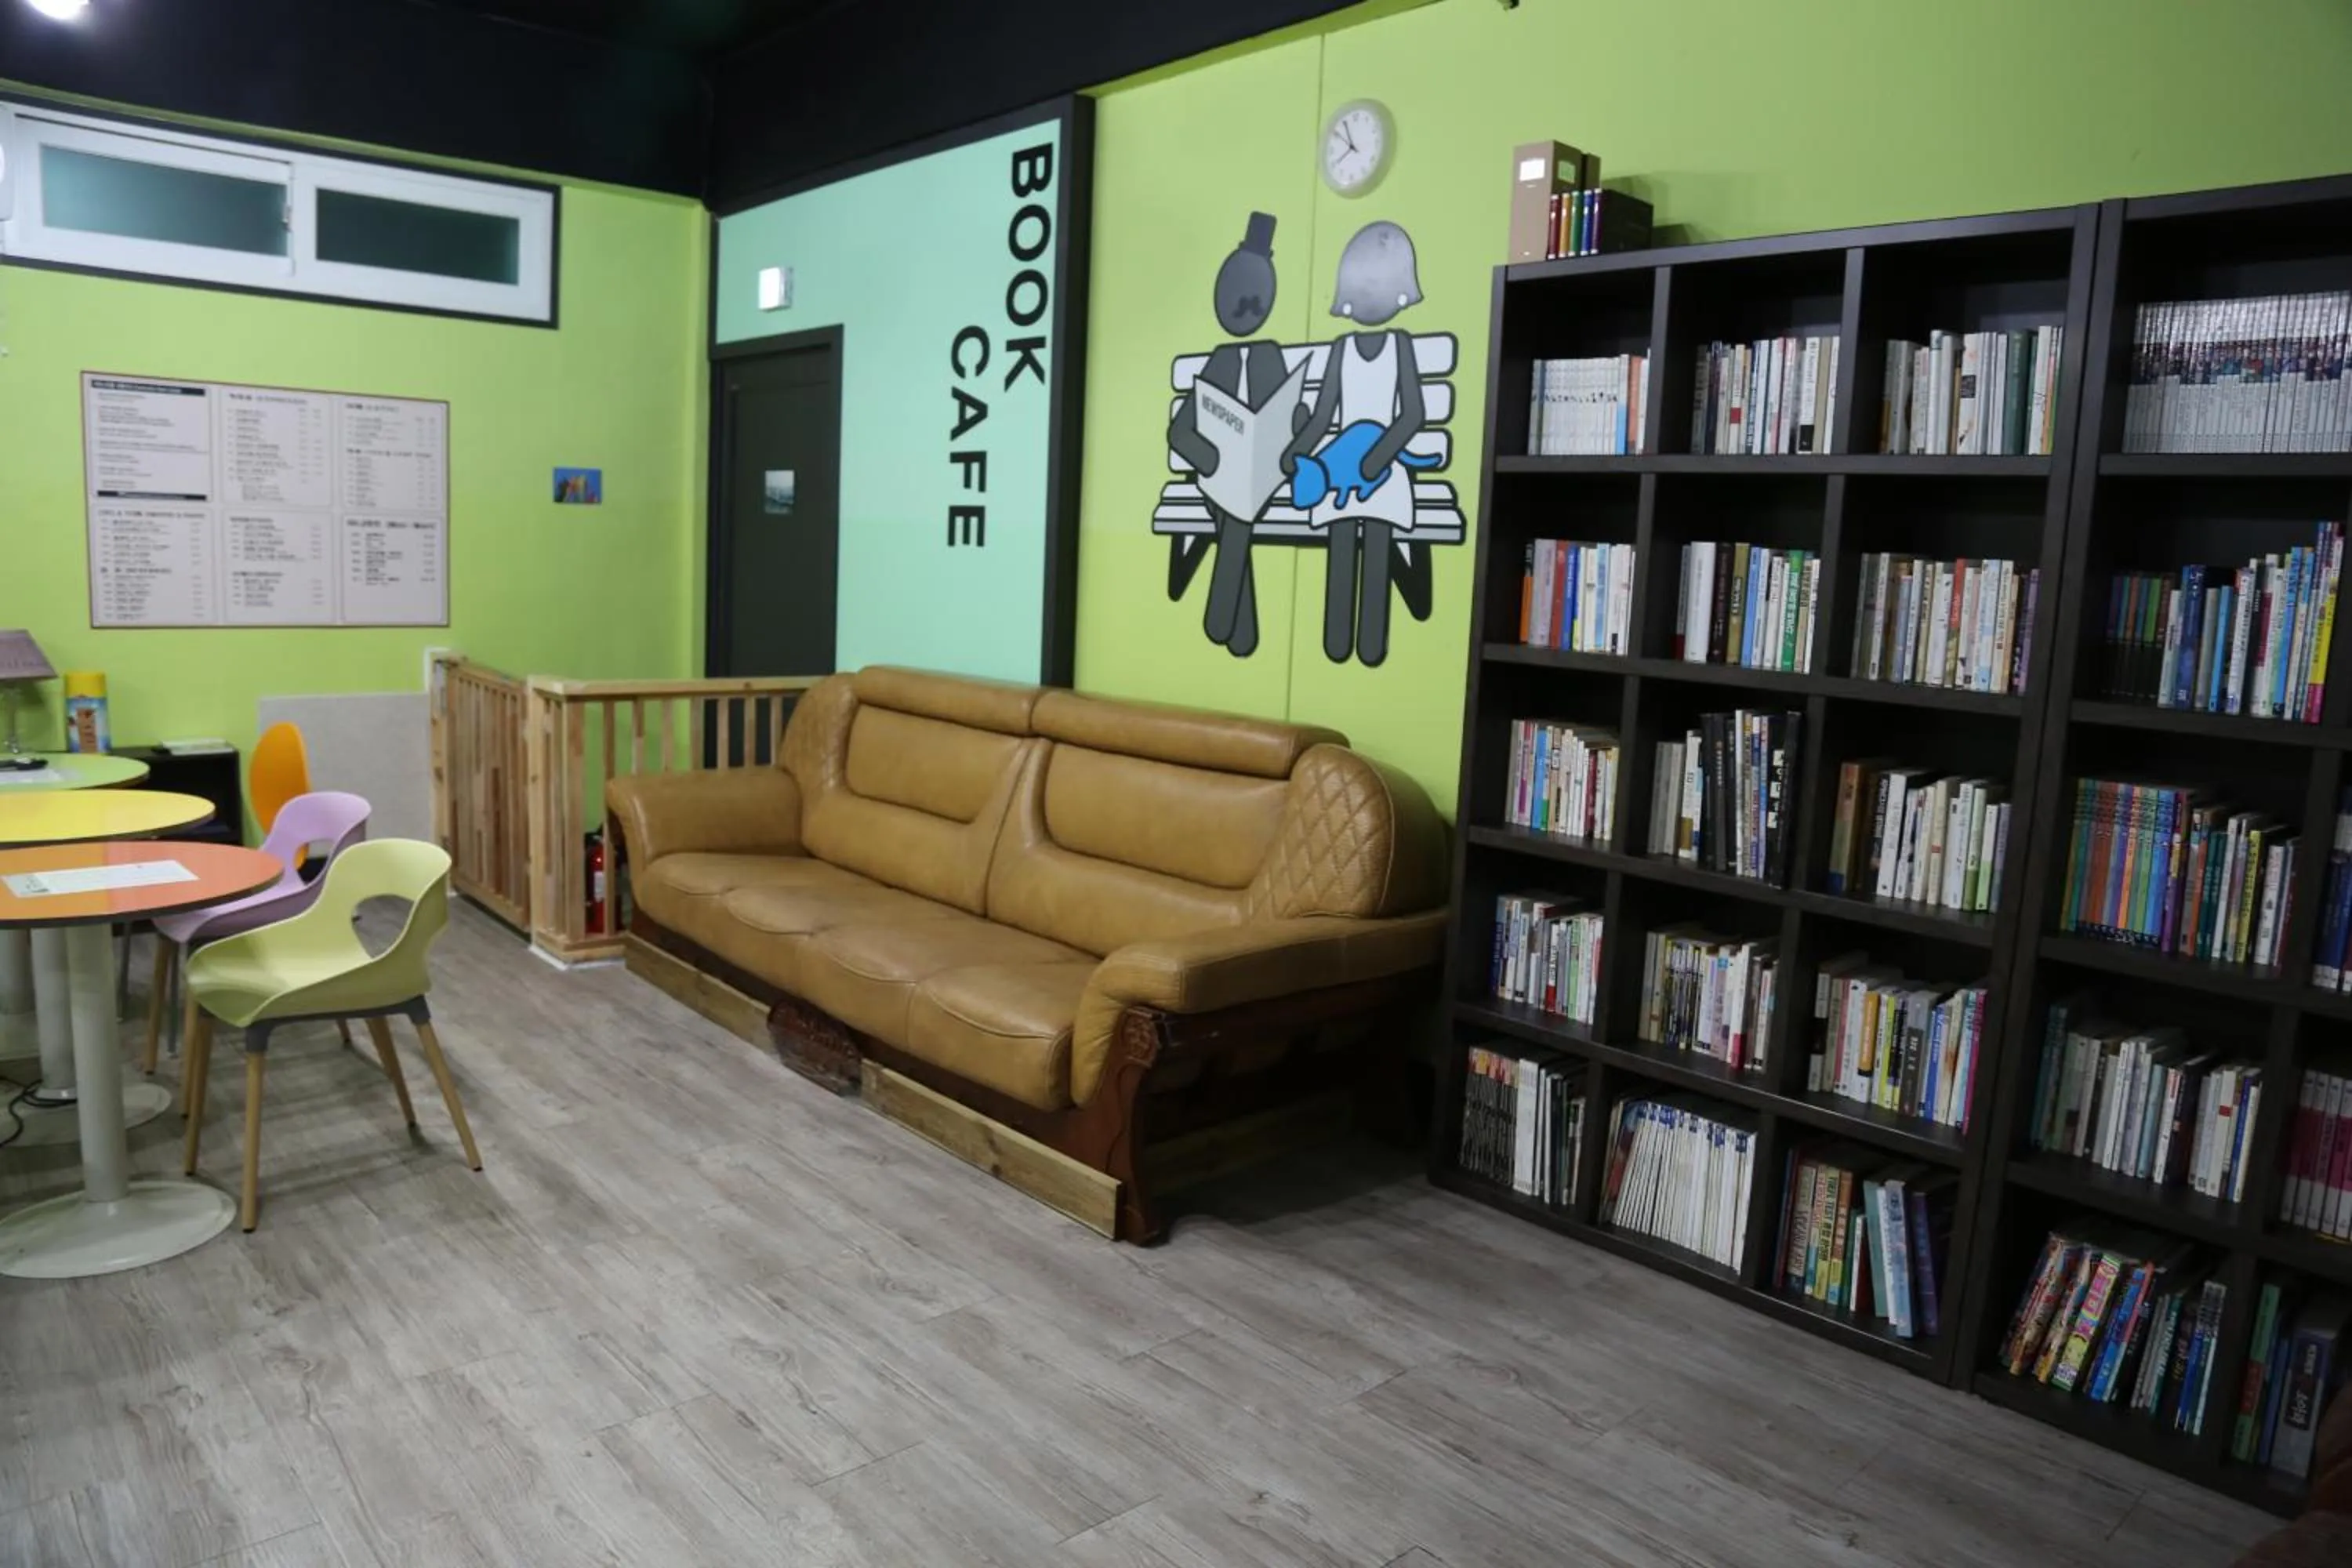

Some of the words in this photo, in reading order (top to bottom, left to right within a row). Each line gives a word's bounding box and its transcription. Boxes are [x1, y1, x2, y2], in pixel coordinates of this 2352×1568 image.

[1004, 143, 1053, 390] BOOK
[948, 325, 990, 546] CAFE
[1202, 394, 1245, 436] NEWSPAPER
